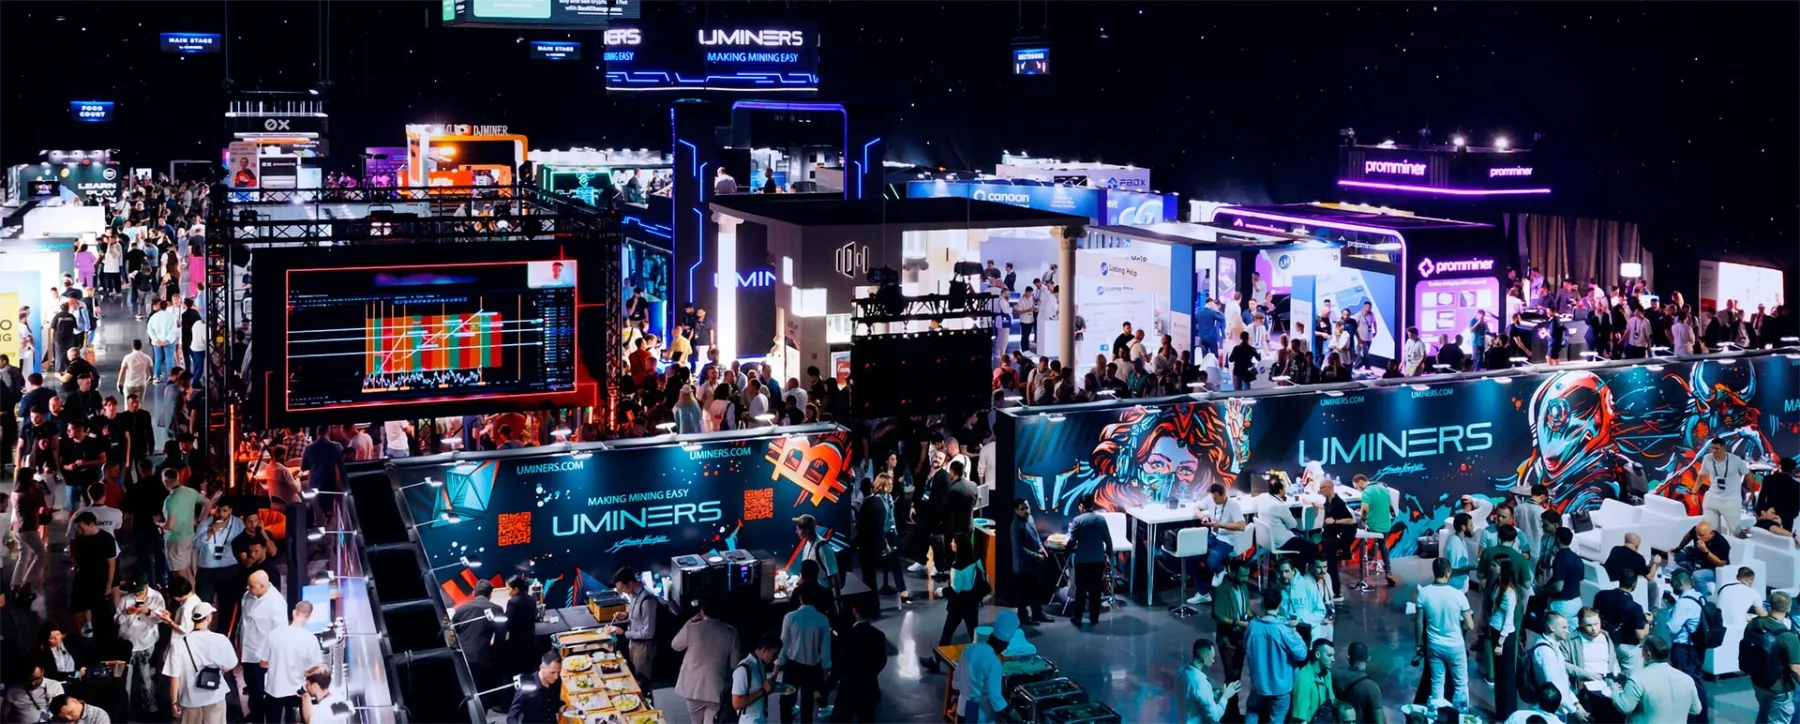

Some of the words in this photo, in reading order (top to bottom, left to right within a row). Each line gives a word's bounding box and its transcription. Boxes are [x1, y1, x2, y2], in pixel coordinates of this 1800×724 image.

[699, 30, 803, 46] UMINERS
[619, 52, 634, 61] EASY
[707, 52, 746, 62] MAKING
[748, 53, 779, 62] MINING
[781, 53, 799, 63] EASY
[473, 125, 508, 136] DJMINER
[1365, 159, 1427, 176] promminer
[1489, 165, 1533, 178] promminer
[988, 193, 1030, 203] canaan
[1436, 258, 1494, 275] promminer
[1411, 387, 1454, 398] UMINERS.COM
[1320, 395, 1365, 407] UMINERS.COM
[1298, 422, 1493, 468] UMINERS
[689, 447, 751, 460] UMINERS.COM
[516, 461, 584, 475] UMINERS.COM
[588, 494, 627, 506] MAKING
[628, 491, 664, 503] MINING
[665, 488, 689, 499] EASY
[552, 500, 722, 536] UMINERS
